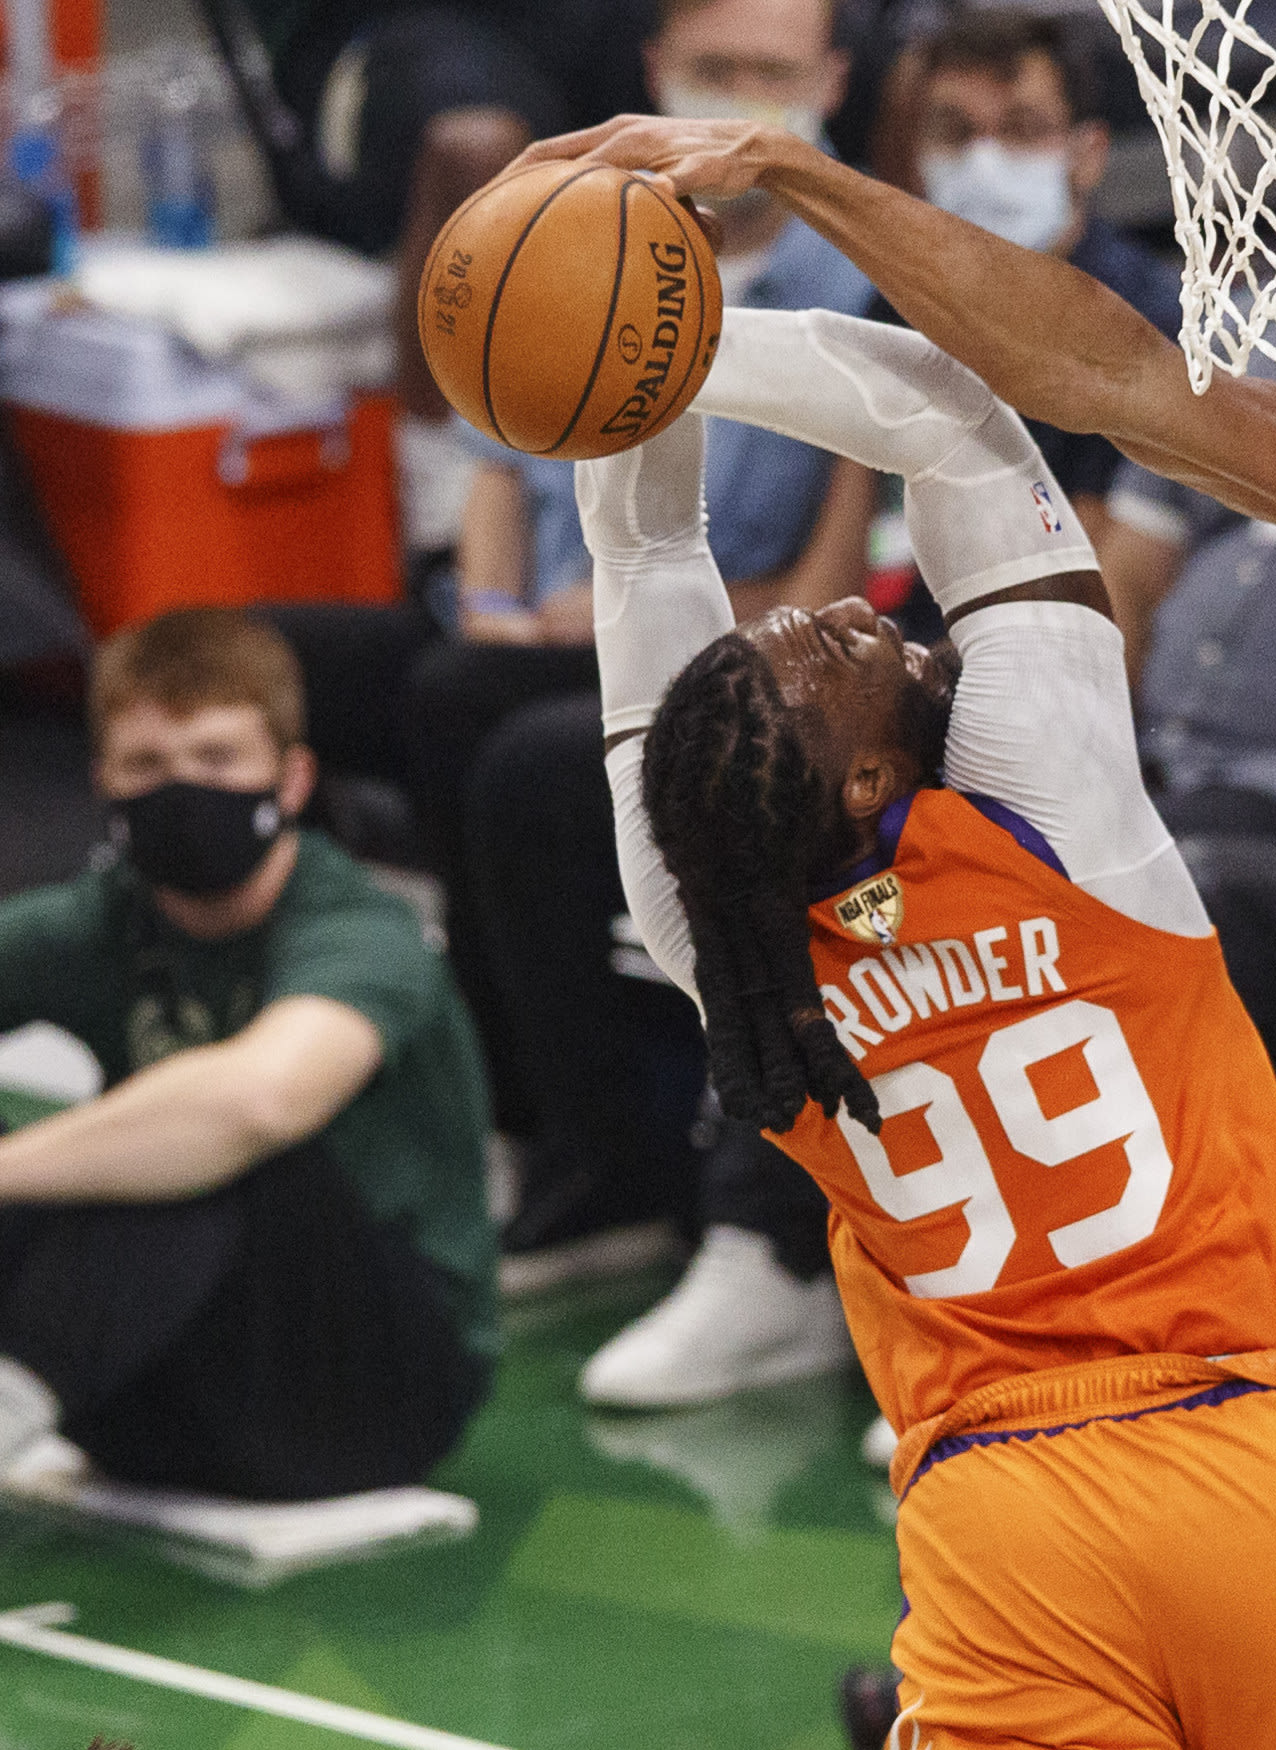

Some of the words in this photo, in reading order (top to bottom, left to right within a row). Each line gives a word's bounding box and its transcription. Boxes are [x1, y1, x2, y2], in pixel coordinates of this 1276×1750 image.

[600, 242, 687, 438] SPALDING
[838, 897, 865, 922] NBA
[860, 877, 899, 914] FINALS
[820, 916, 1068, 1061] ROWDER
[836, 999, 1174, 1300] 99
